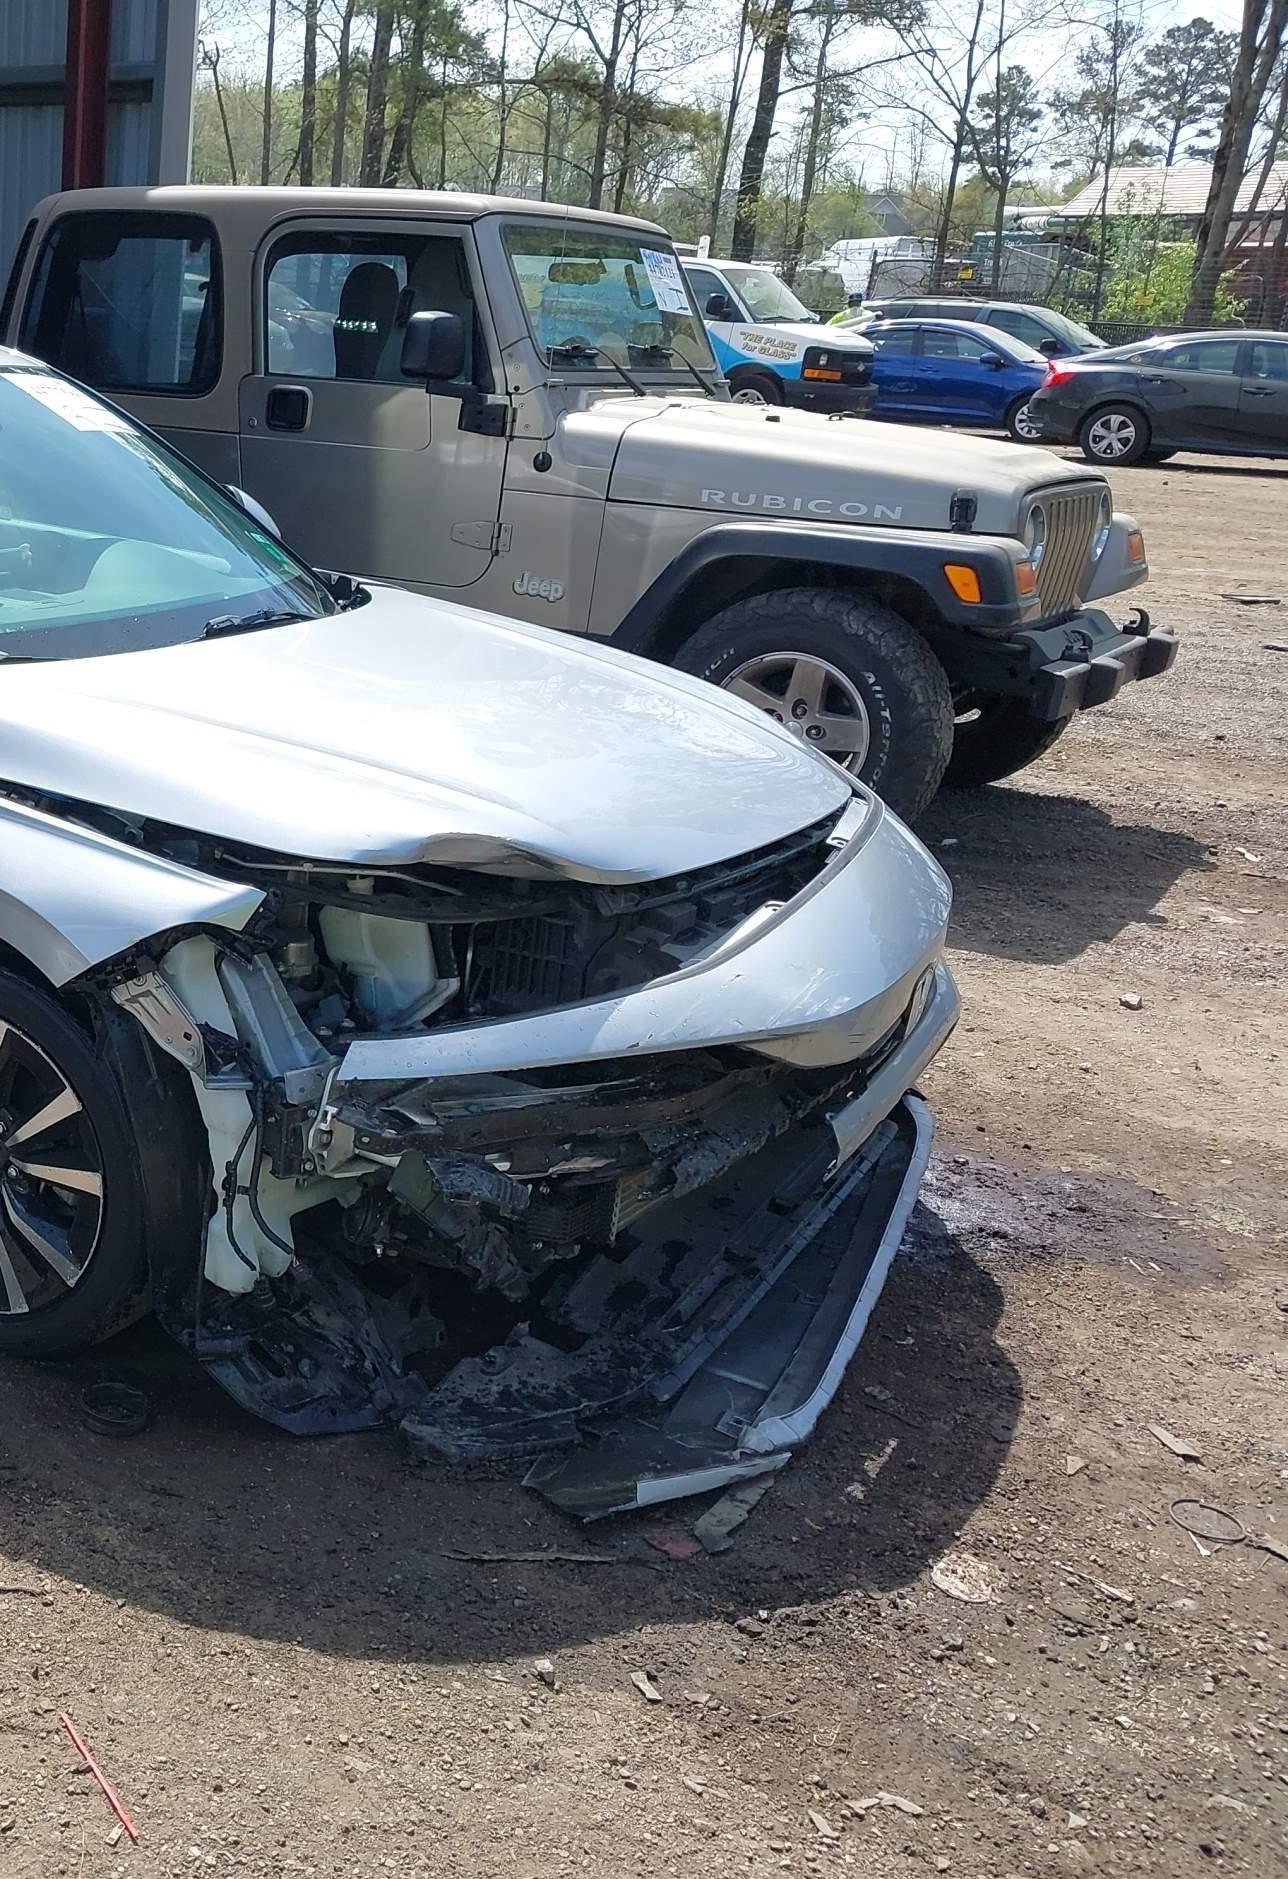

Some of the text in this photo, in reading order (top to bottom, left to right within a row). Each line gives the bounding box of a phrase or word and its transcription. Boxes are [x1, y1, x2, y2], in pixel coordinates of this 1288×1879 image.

[740, 331, 797, 351] "THE PLACE
[742, 342, 797, 360] for GLASS"
[700, 488, 904, 520] RUBICON
[512, 571, 565, 603] Jeep
